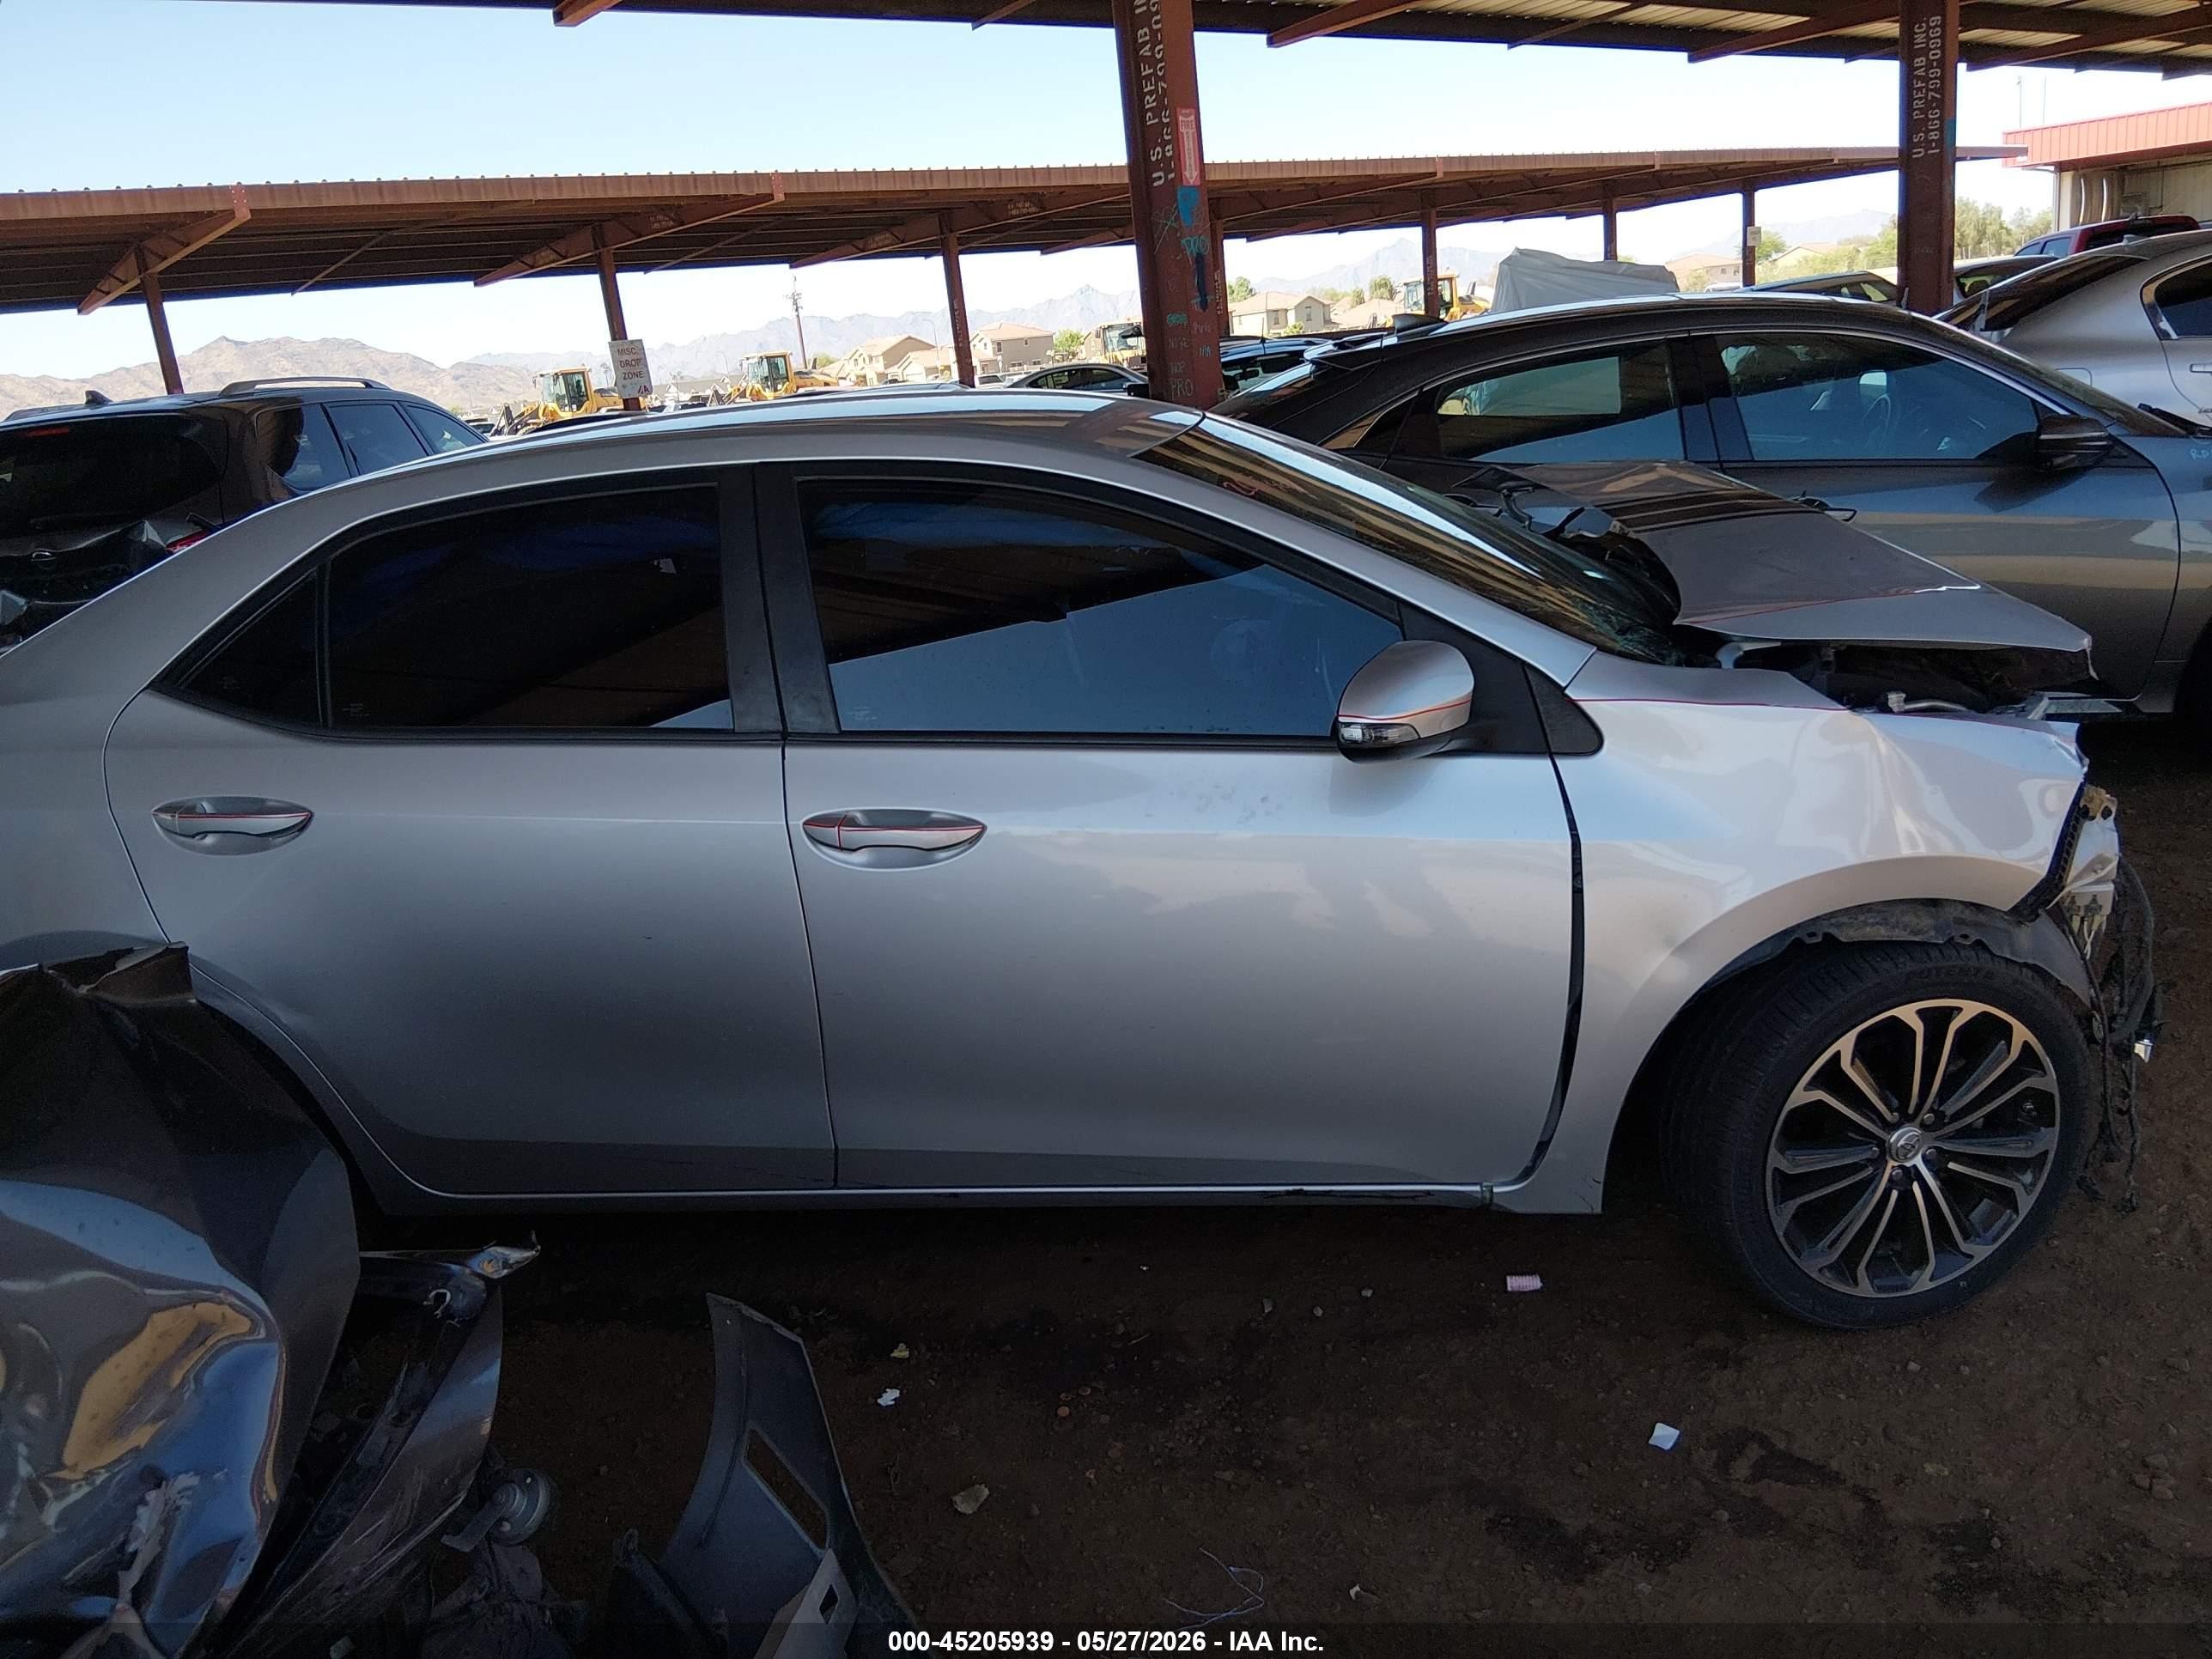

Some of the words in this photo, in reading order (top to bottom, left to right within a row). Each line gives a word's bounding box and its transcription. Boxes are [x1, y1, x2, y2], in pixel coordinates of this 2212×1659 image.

[1914, 16, 1927, 49] INC.
[1137, 27, 1159, 125] PREFAB
[1913, 57, 1927, 119] PREFAB
[1928, 15, 1942, 155] 1-866-799-0969
[1912, 127, 1925, 159] U.S.
[1150, 137, 1165, 187] U.S.
[617, 347, 640, 356] MISC.
[619, 358, 641, 368] DROP
[622, 370, 644, 380] ZONE
